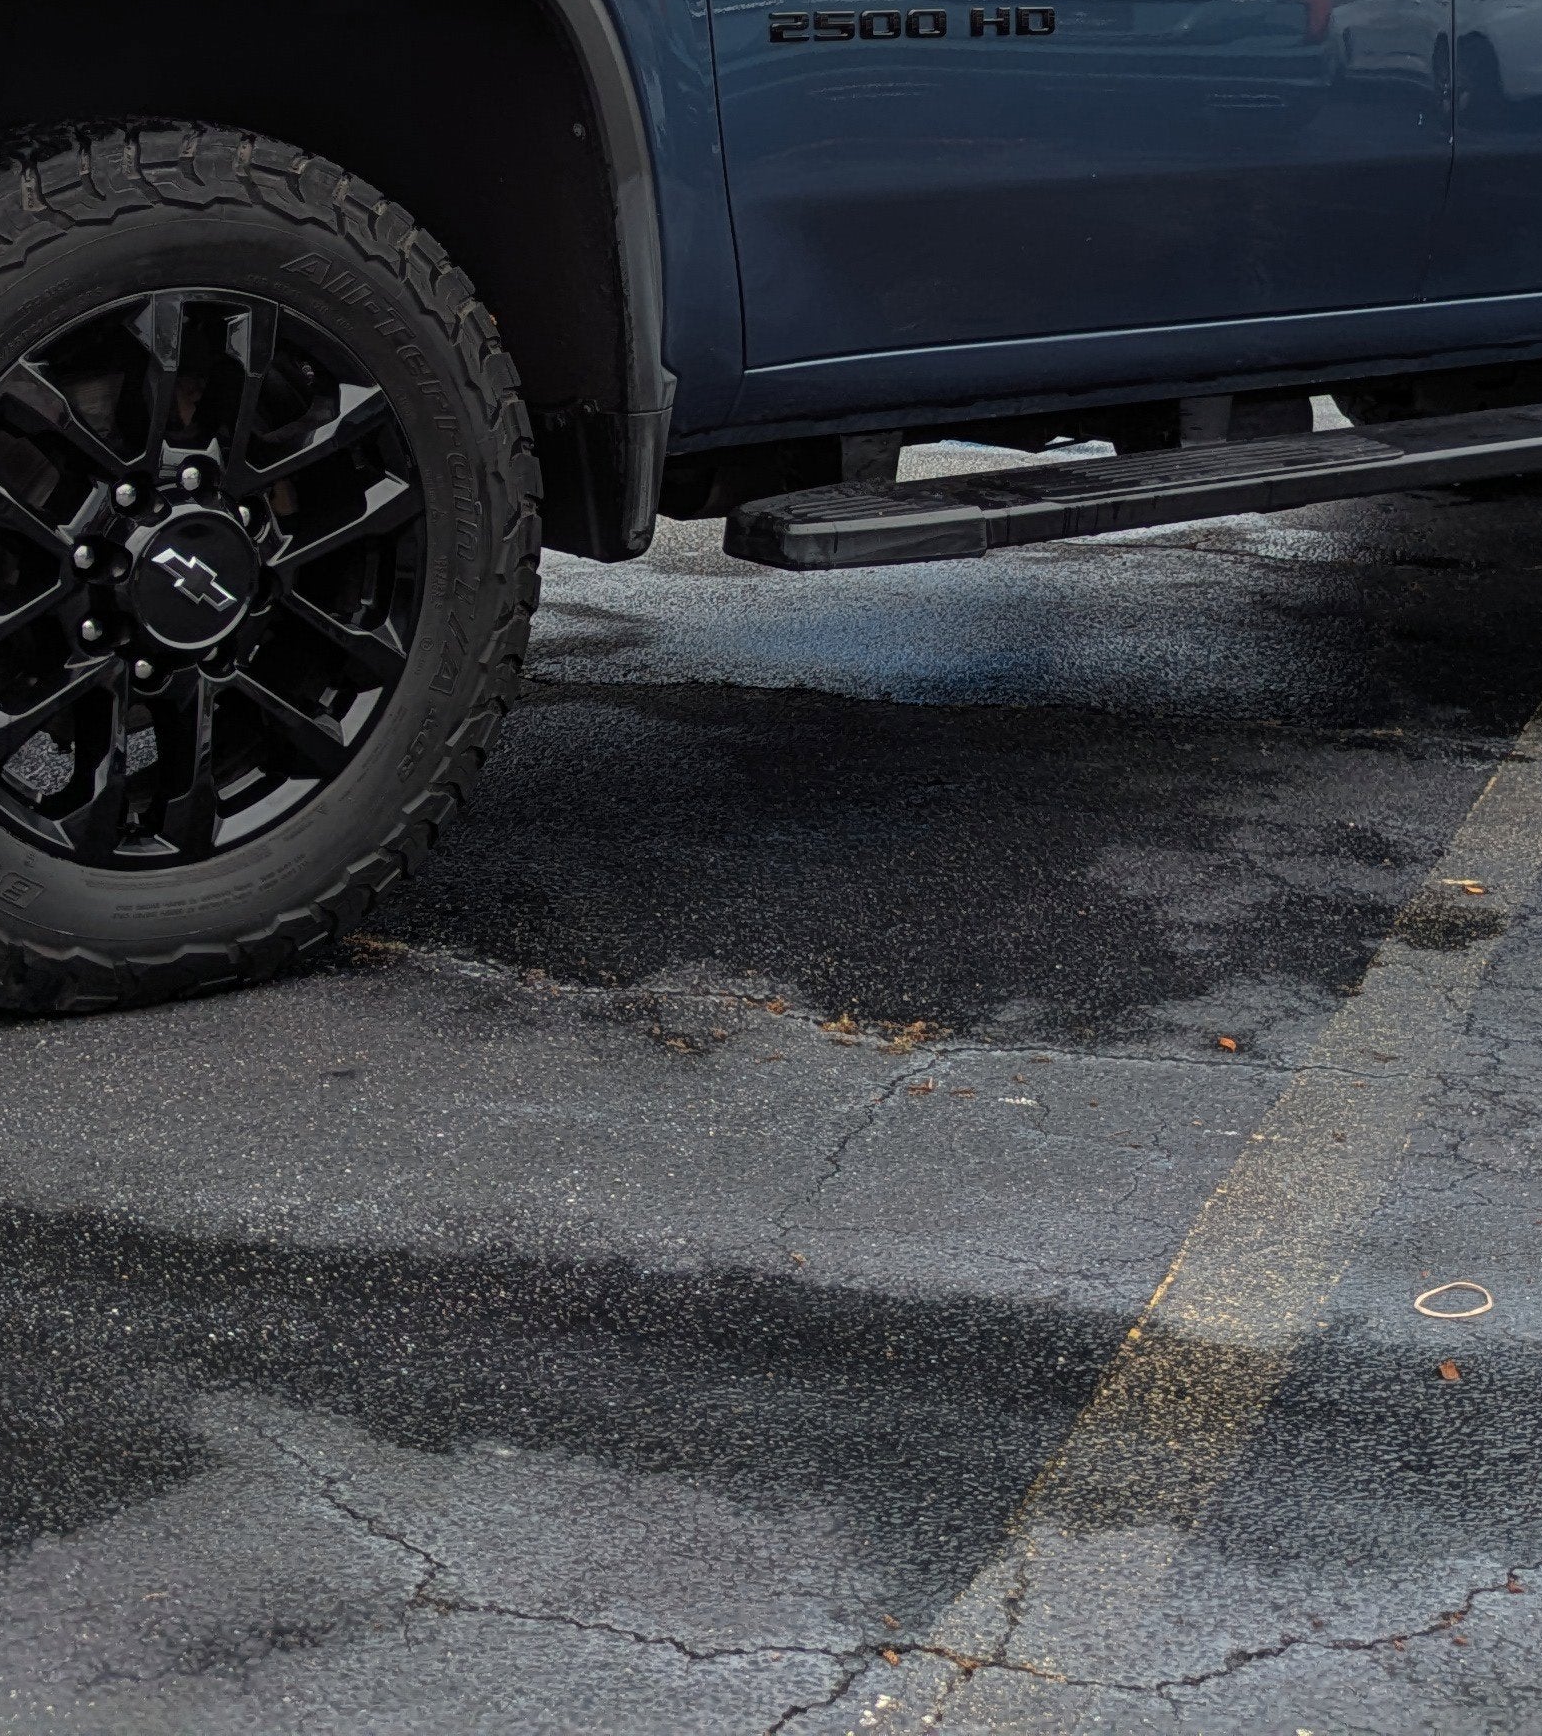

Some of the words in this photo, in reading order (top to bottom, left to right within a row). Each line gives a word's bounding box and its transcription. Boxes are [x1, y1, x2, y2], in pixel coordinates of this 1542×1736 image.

[768, 8, 948, 43] 2500
[970, 6, 1056, 37] HD
[280, 252, 481, 562] All-Terrain
